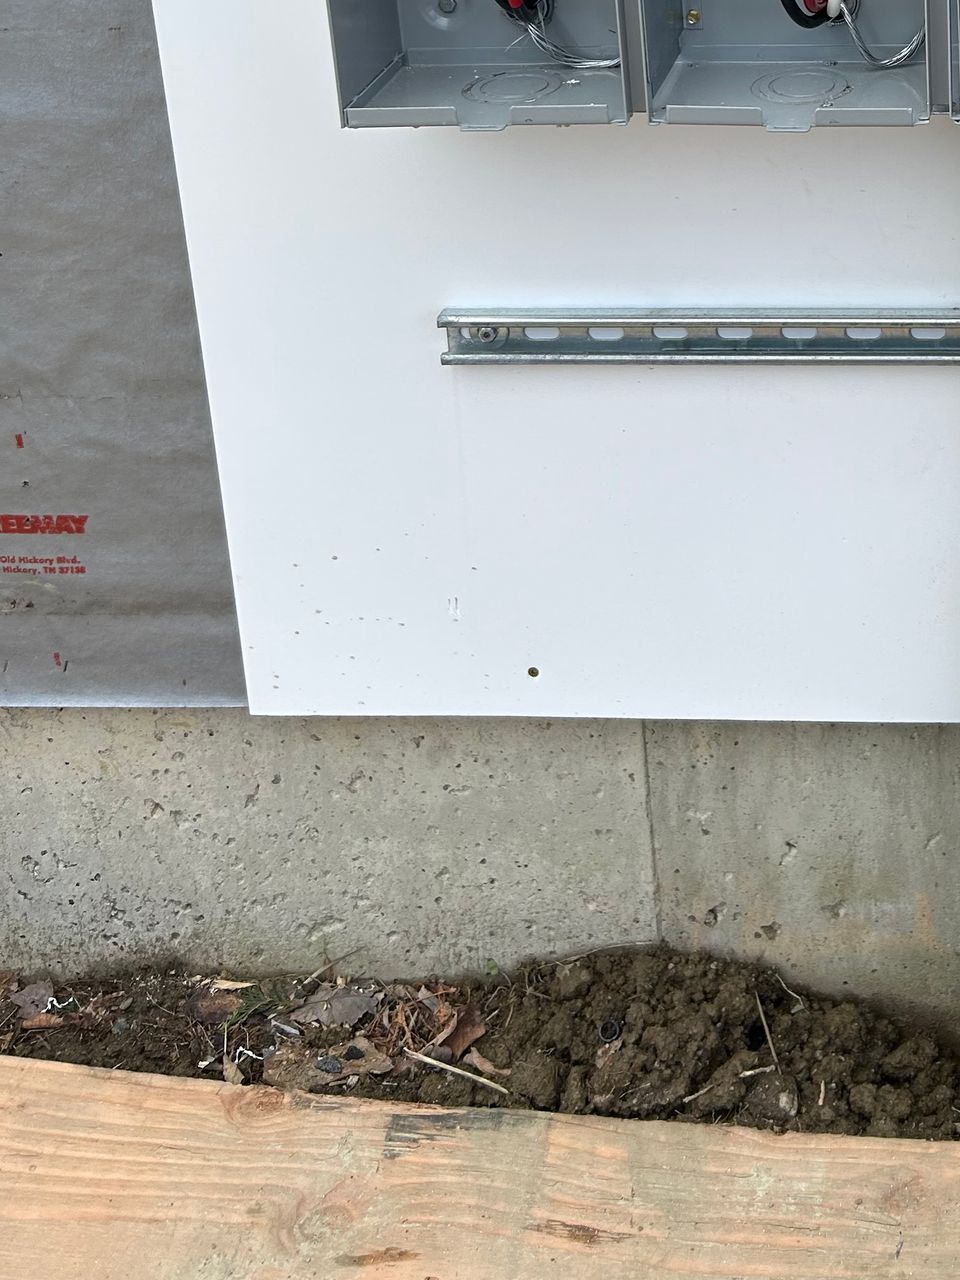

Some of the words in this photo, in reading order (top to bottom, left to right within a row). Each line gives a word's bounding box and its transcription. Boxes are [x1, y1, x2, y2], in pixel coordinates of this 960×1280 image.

[19, 556, 54, 565] Hickory
[57, 555, 81, 564] Blvd.
[3, 566, 41, 575] Hickory,
[43, 566, 56, 574] TN
